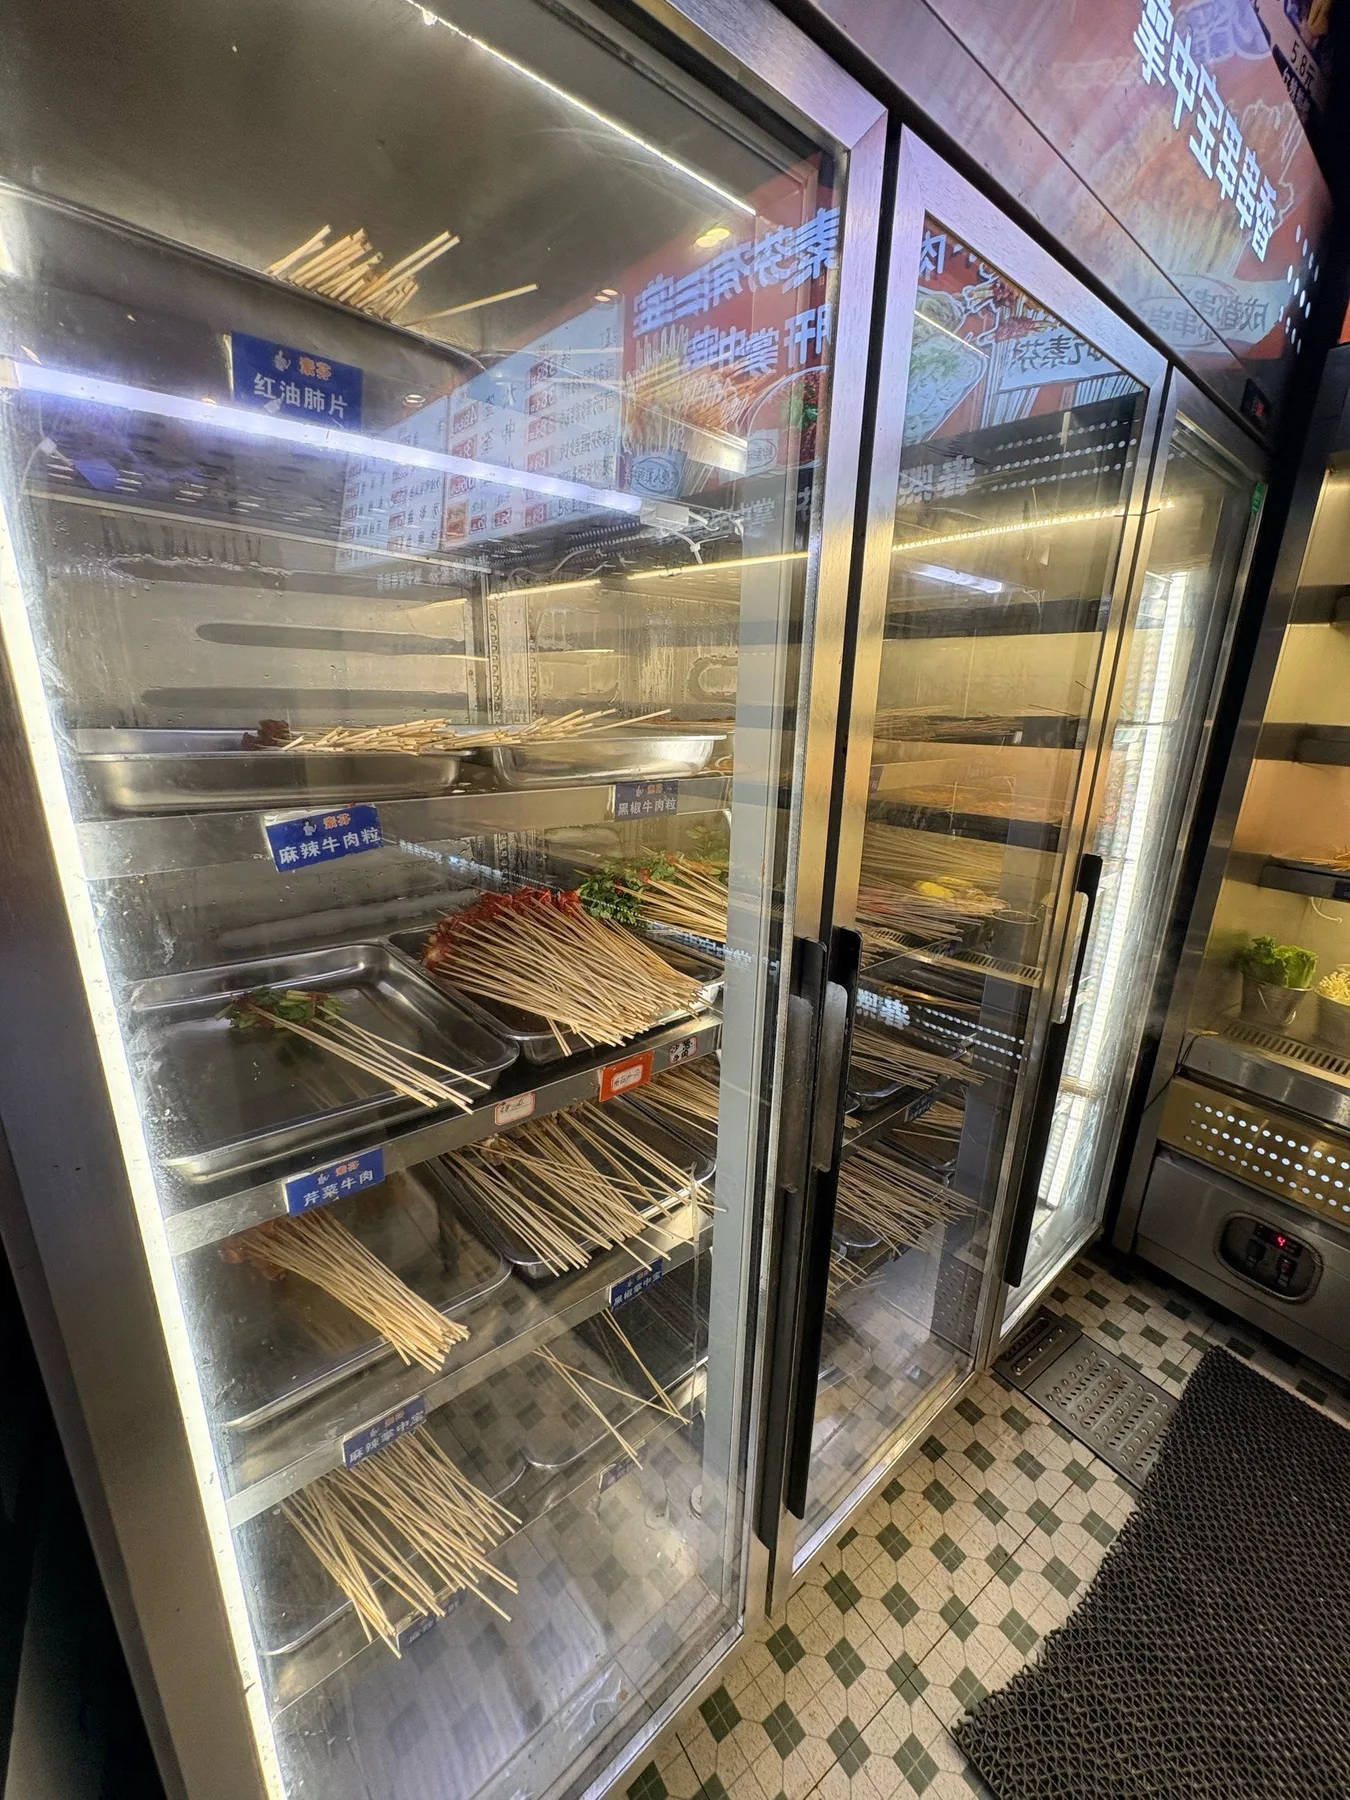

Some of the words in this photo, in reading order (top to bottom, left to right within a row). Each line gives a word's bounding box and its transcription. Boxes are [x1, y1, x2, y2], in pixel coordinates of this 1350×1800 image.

[253, 372, 349, 420] 红油肺片
[617, 797, 677, 817] 黑椒牛肉粒
[278, 826, 382, 865] 麻辣牛肉粒
[303, 1169, 374, 1208] 芹菜牛肉
[348, 1409, 424, 1464] 麻辣掌中宝
